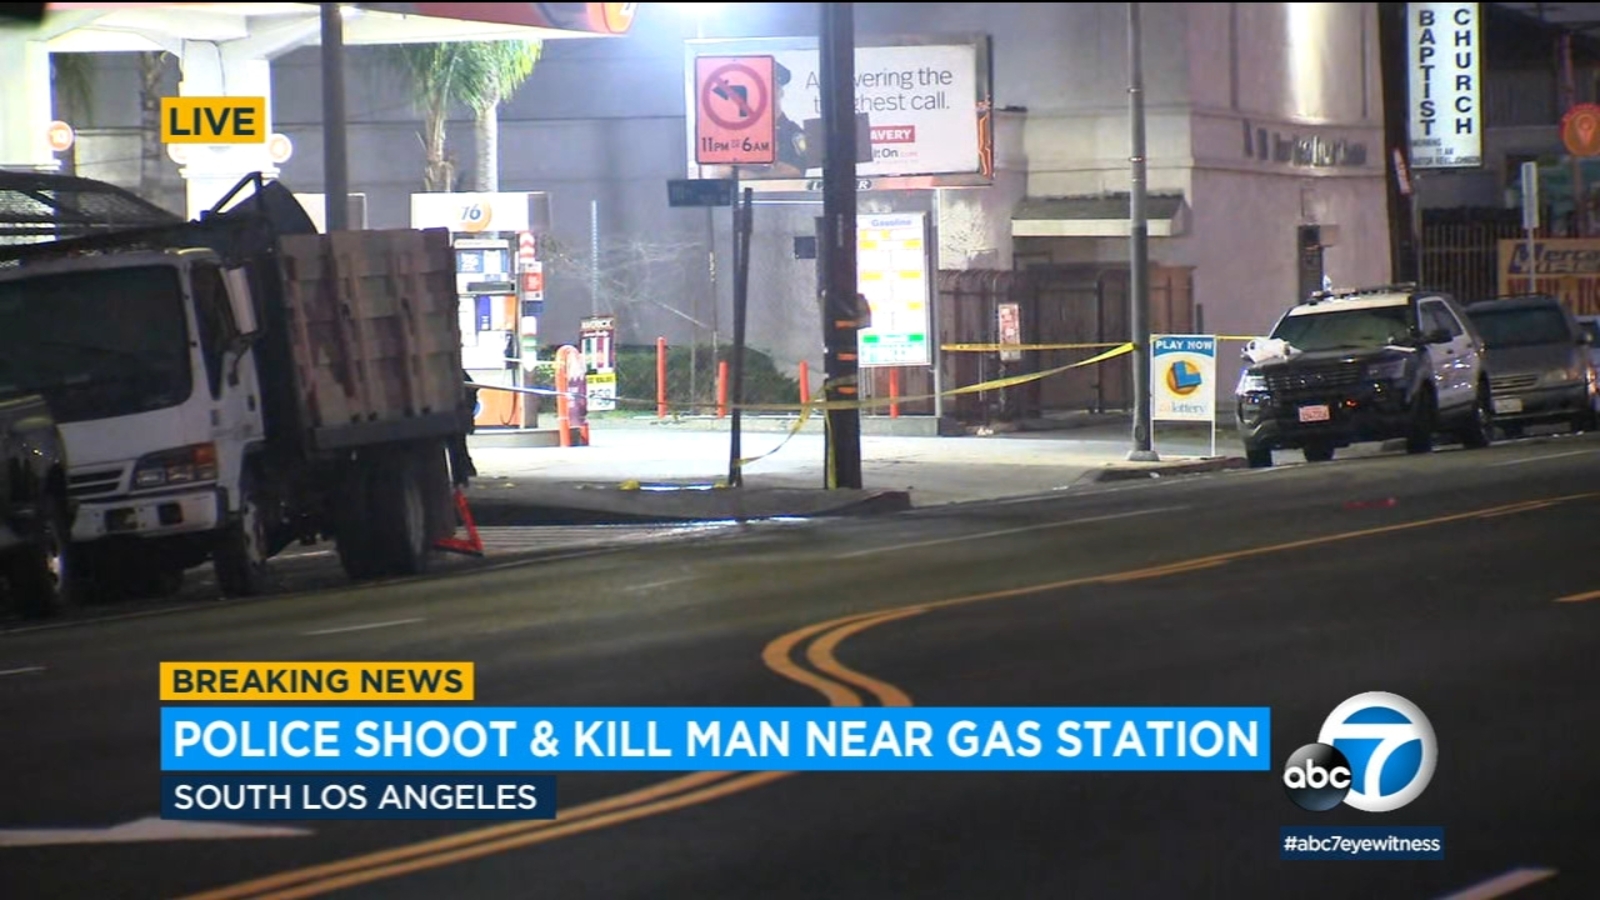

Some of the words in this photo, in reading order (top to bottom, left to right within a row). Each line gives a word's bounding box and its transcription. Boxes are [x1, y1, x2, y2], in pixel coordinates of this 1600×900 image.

[918, 66, 953, 87] the
[1419, 9, 1436, 136] BAPTIST
[1454, 8, 1472, 134] CHURCH
[911, 91, 951, 111] call.
[742, 137, 770, 152] 6AM
[461, 204, 482, 221] 76
[871, 219, 912, 227] Gasoline
[1155, 340, 1185, 350] PLAY
[1188, 340, 1213, 350] NOW
